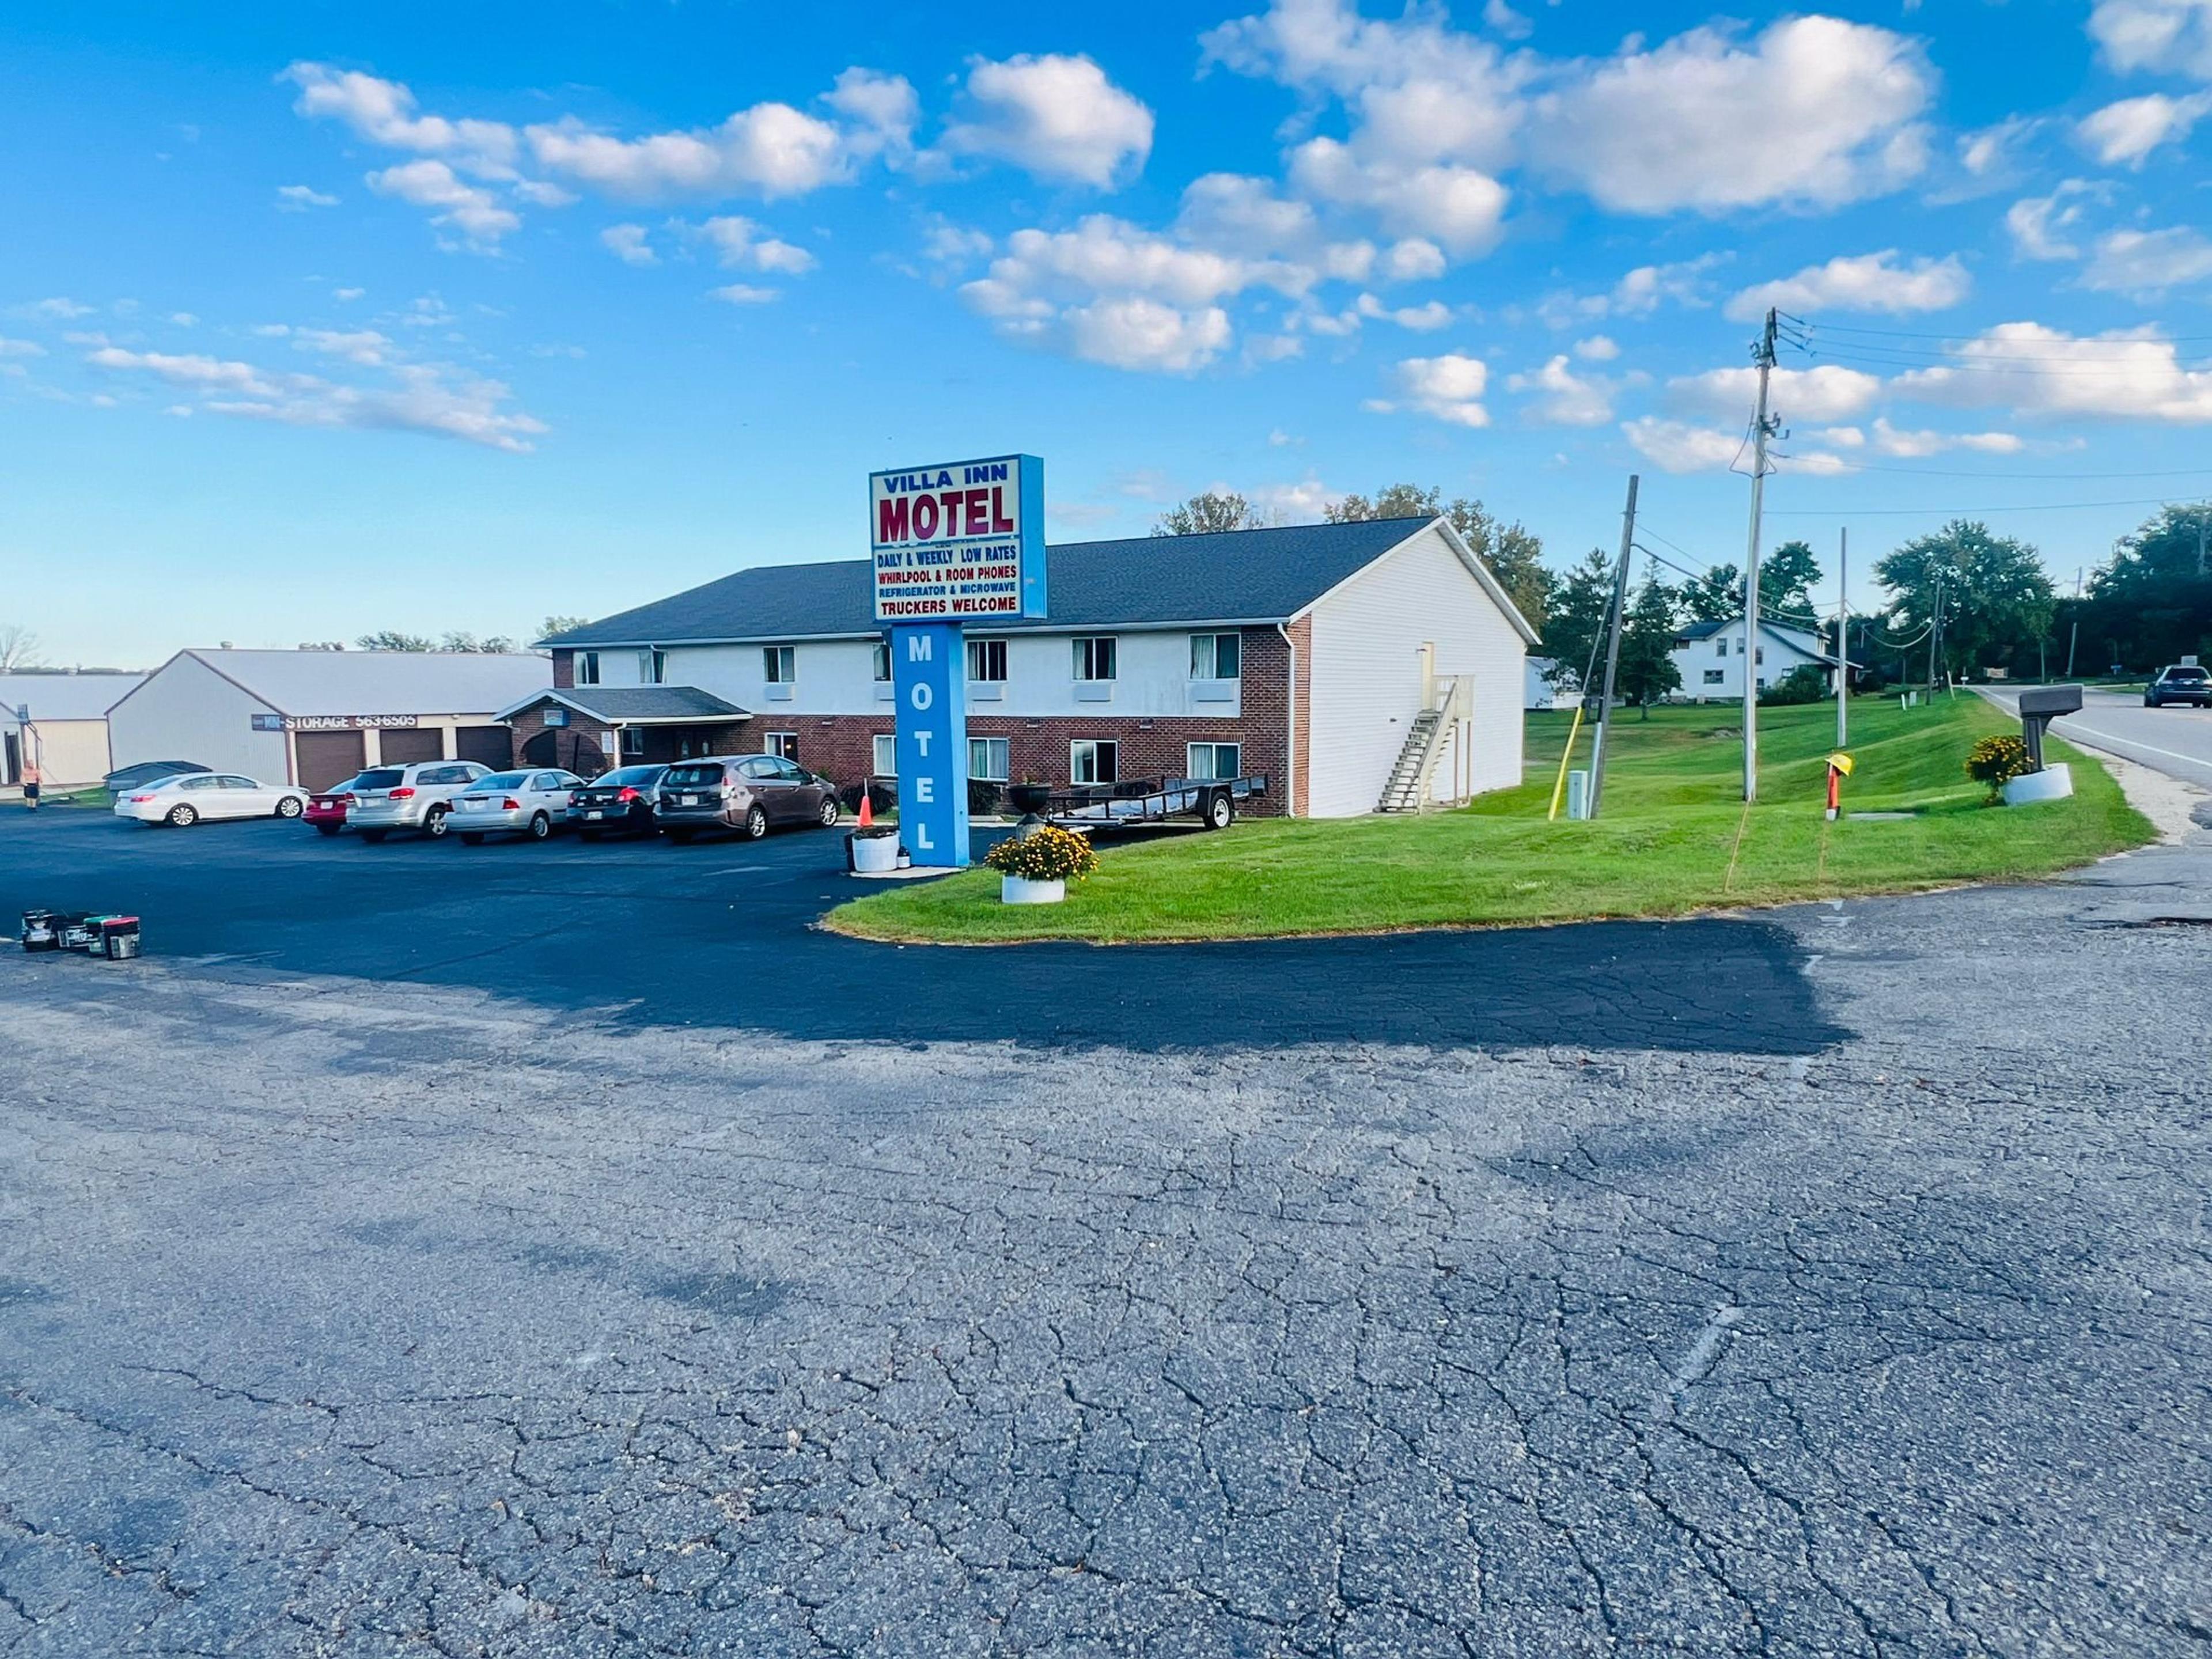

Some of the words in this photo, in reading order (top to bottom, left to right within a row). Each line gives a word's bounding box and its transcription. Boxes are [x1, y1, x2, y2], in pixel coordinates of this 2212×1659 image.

[884, 470, 953, 494] VILLA
[964, 464, 1007, 484] INN
[880, 486, 1014, 543] MOTEL
[877, 552, 902, 568] DAILY
[907, 552, 913, 566] &
[916, 550, 953, 565] WEEKLY
[960, 548, 982, 563] LOW
[985, 545, 1016, 561] RATES
[878, 570, 932, 585] WHIRLPOOL
[935, 569, 942, 582] &
[946, 567, 974, 581] ROOM
[978, 565, 1017, 579] PHONES
[879, 586, 946, 598] REFRIGERATOR
[950, 585, 956, 594] &
[960, 582, 1016, 594] MICROWAVE
[881, 599, 946, 615] TRUCKERS
[952, 596, 1016, 612] WELCOME
[908, 635, 934, 850] MOTEL
